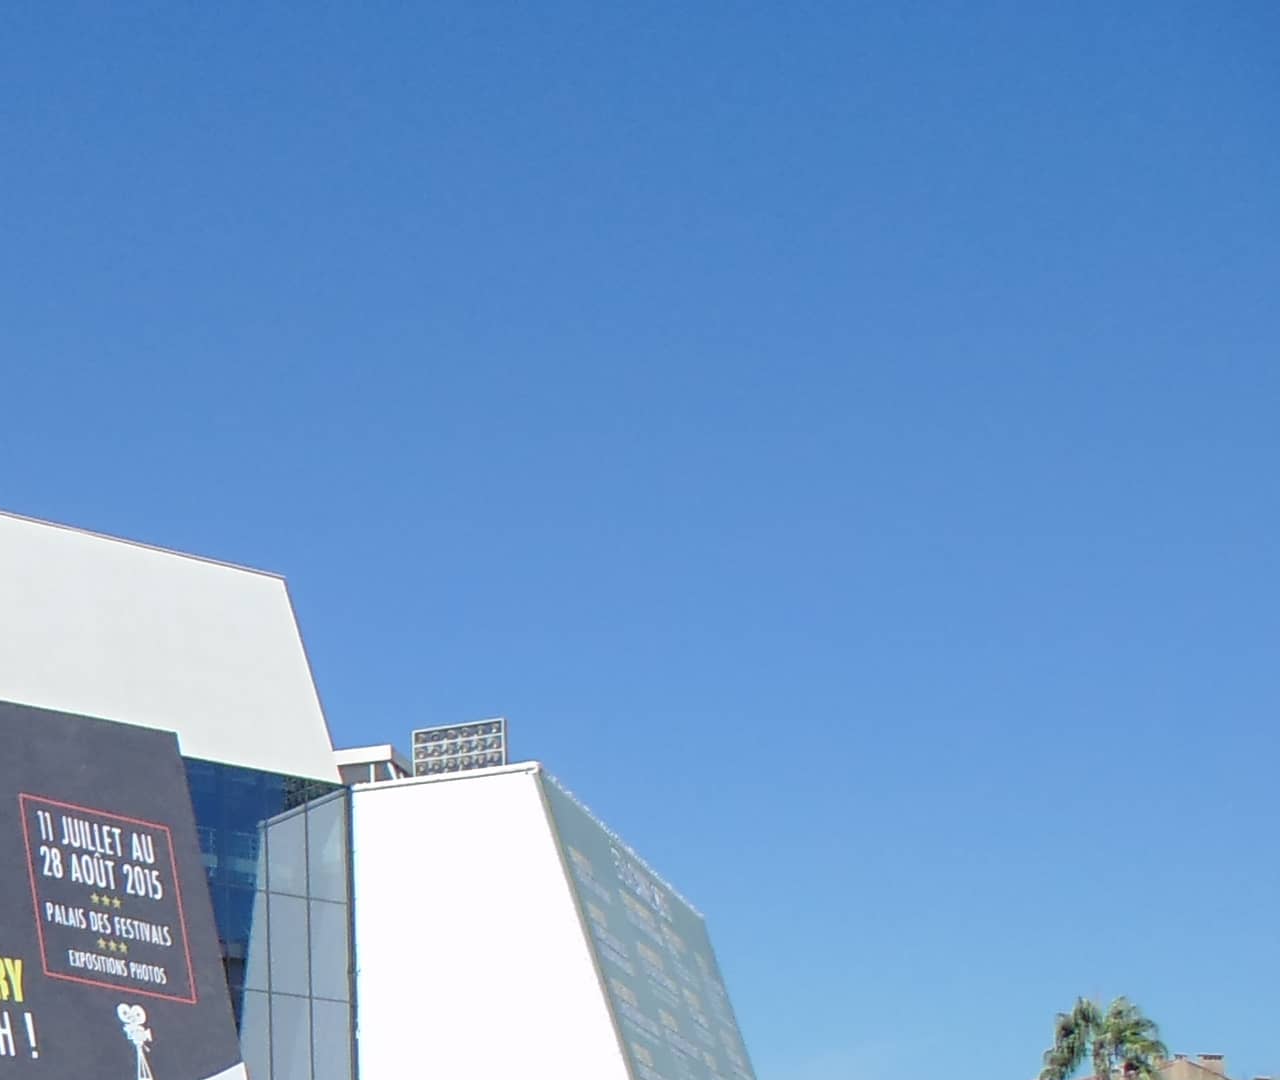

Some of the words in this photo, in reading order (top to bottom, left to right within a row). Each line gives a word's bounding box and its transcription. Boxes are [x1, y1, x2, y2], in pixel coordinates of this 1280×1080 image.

[37, 810, 54, 842] 11
[62, 815, 122, 857] JUILLET
[132, 832, 155, 864] AU
[40, 846, 63, 879] 28
[71, 852, 115, 890] AOÛT
[123, 864, 162, 900] 2015
[45, 902, 87, 929] PALAIS
[90, 911, 111, 934] DES
[114, 916, 172, 947] FESTIVALS
[69, 949, 128, 978] EXPOSITIONS
[130, 961, 167, 985] PHOTOS
[23, 1012, 40, 1059] !
